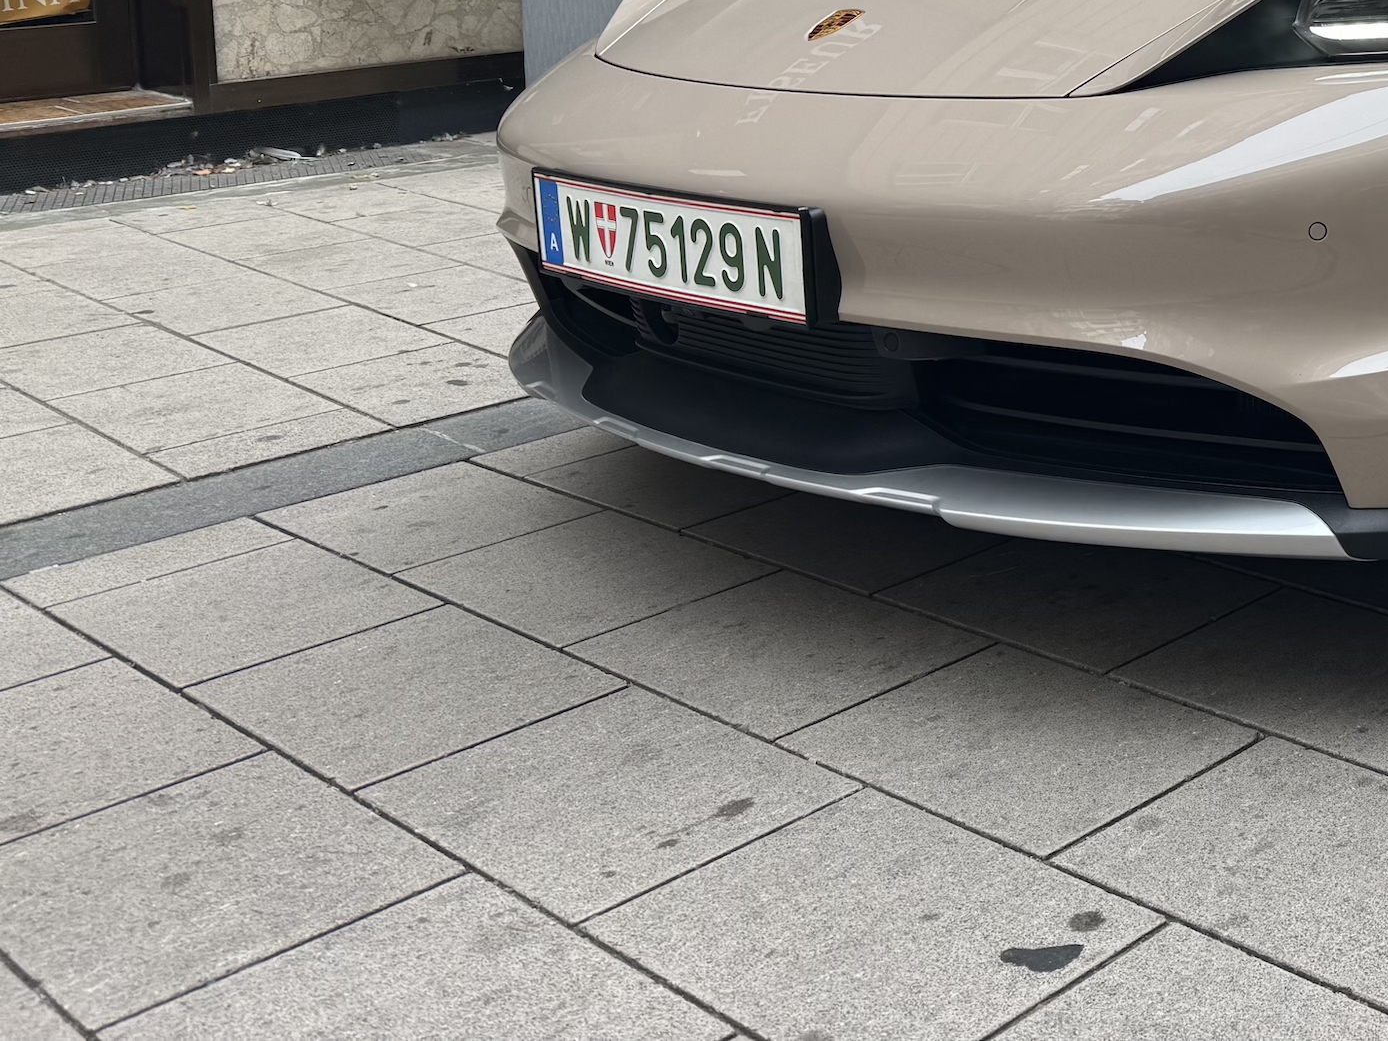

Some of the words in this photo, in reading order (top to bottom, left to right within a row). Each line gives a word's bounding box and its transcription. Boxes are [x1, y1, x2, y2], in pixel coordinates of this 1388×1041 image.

[549, 233, 559, 251] A
[566, 195, 590, 262] W
[619, 206, 745, 292] 75129
[755, 226, 783, 300] N
